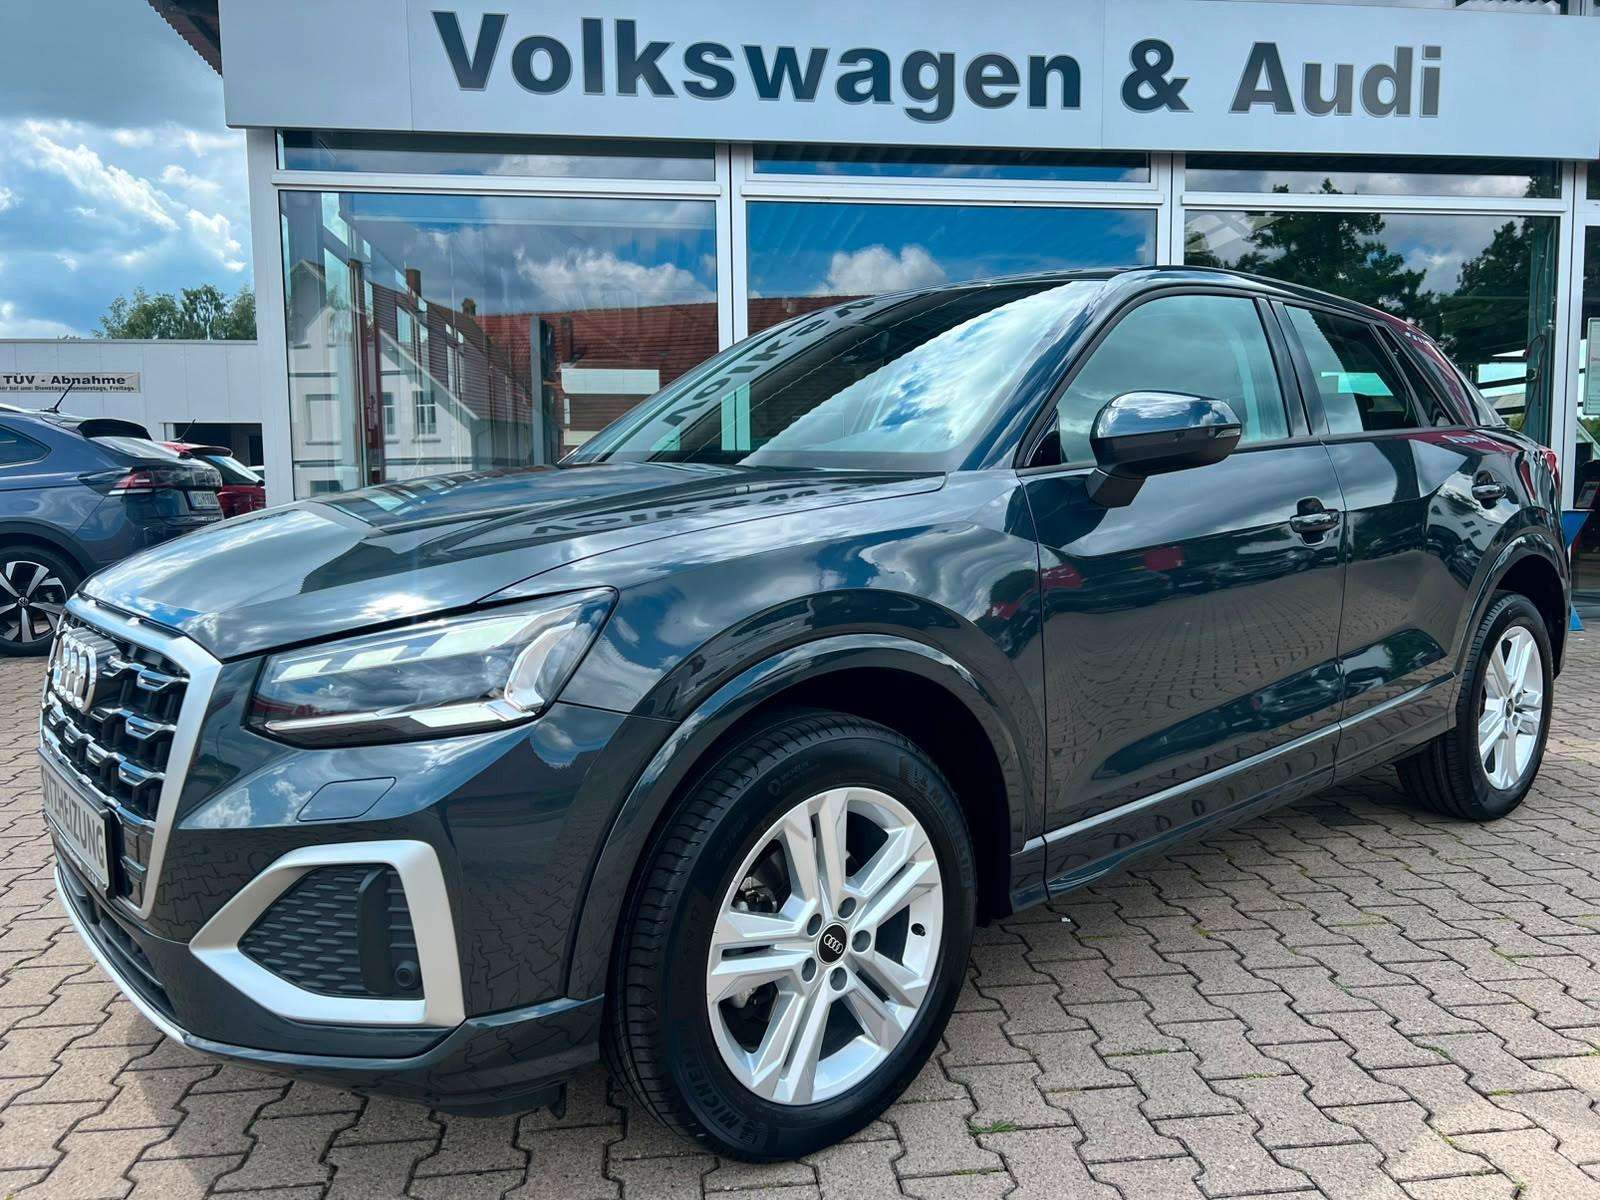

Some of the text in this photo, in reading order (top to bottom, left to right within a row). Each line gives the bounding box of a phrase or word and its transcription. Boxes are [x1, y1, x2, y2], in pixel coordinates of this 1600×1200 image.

[430, 10, 1442, 123] Volkswagen & Audi
[3, 372, 35, 384] TÜV
[51, 374, 126, 385] Abnahme
